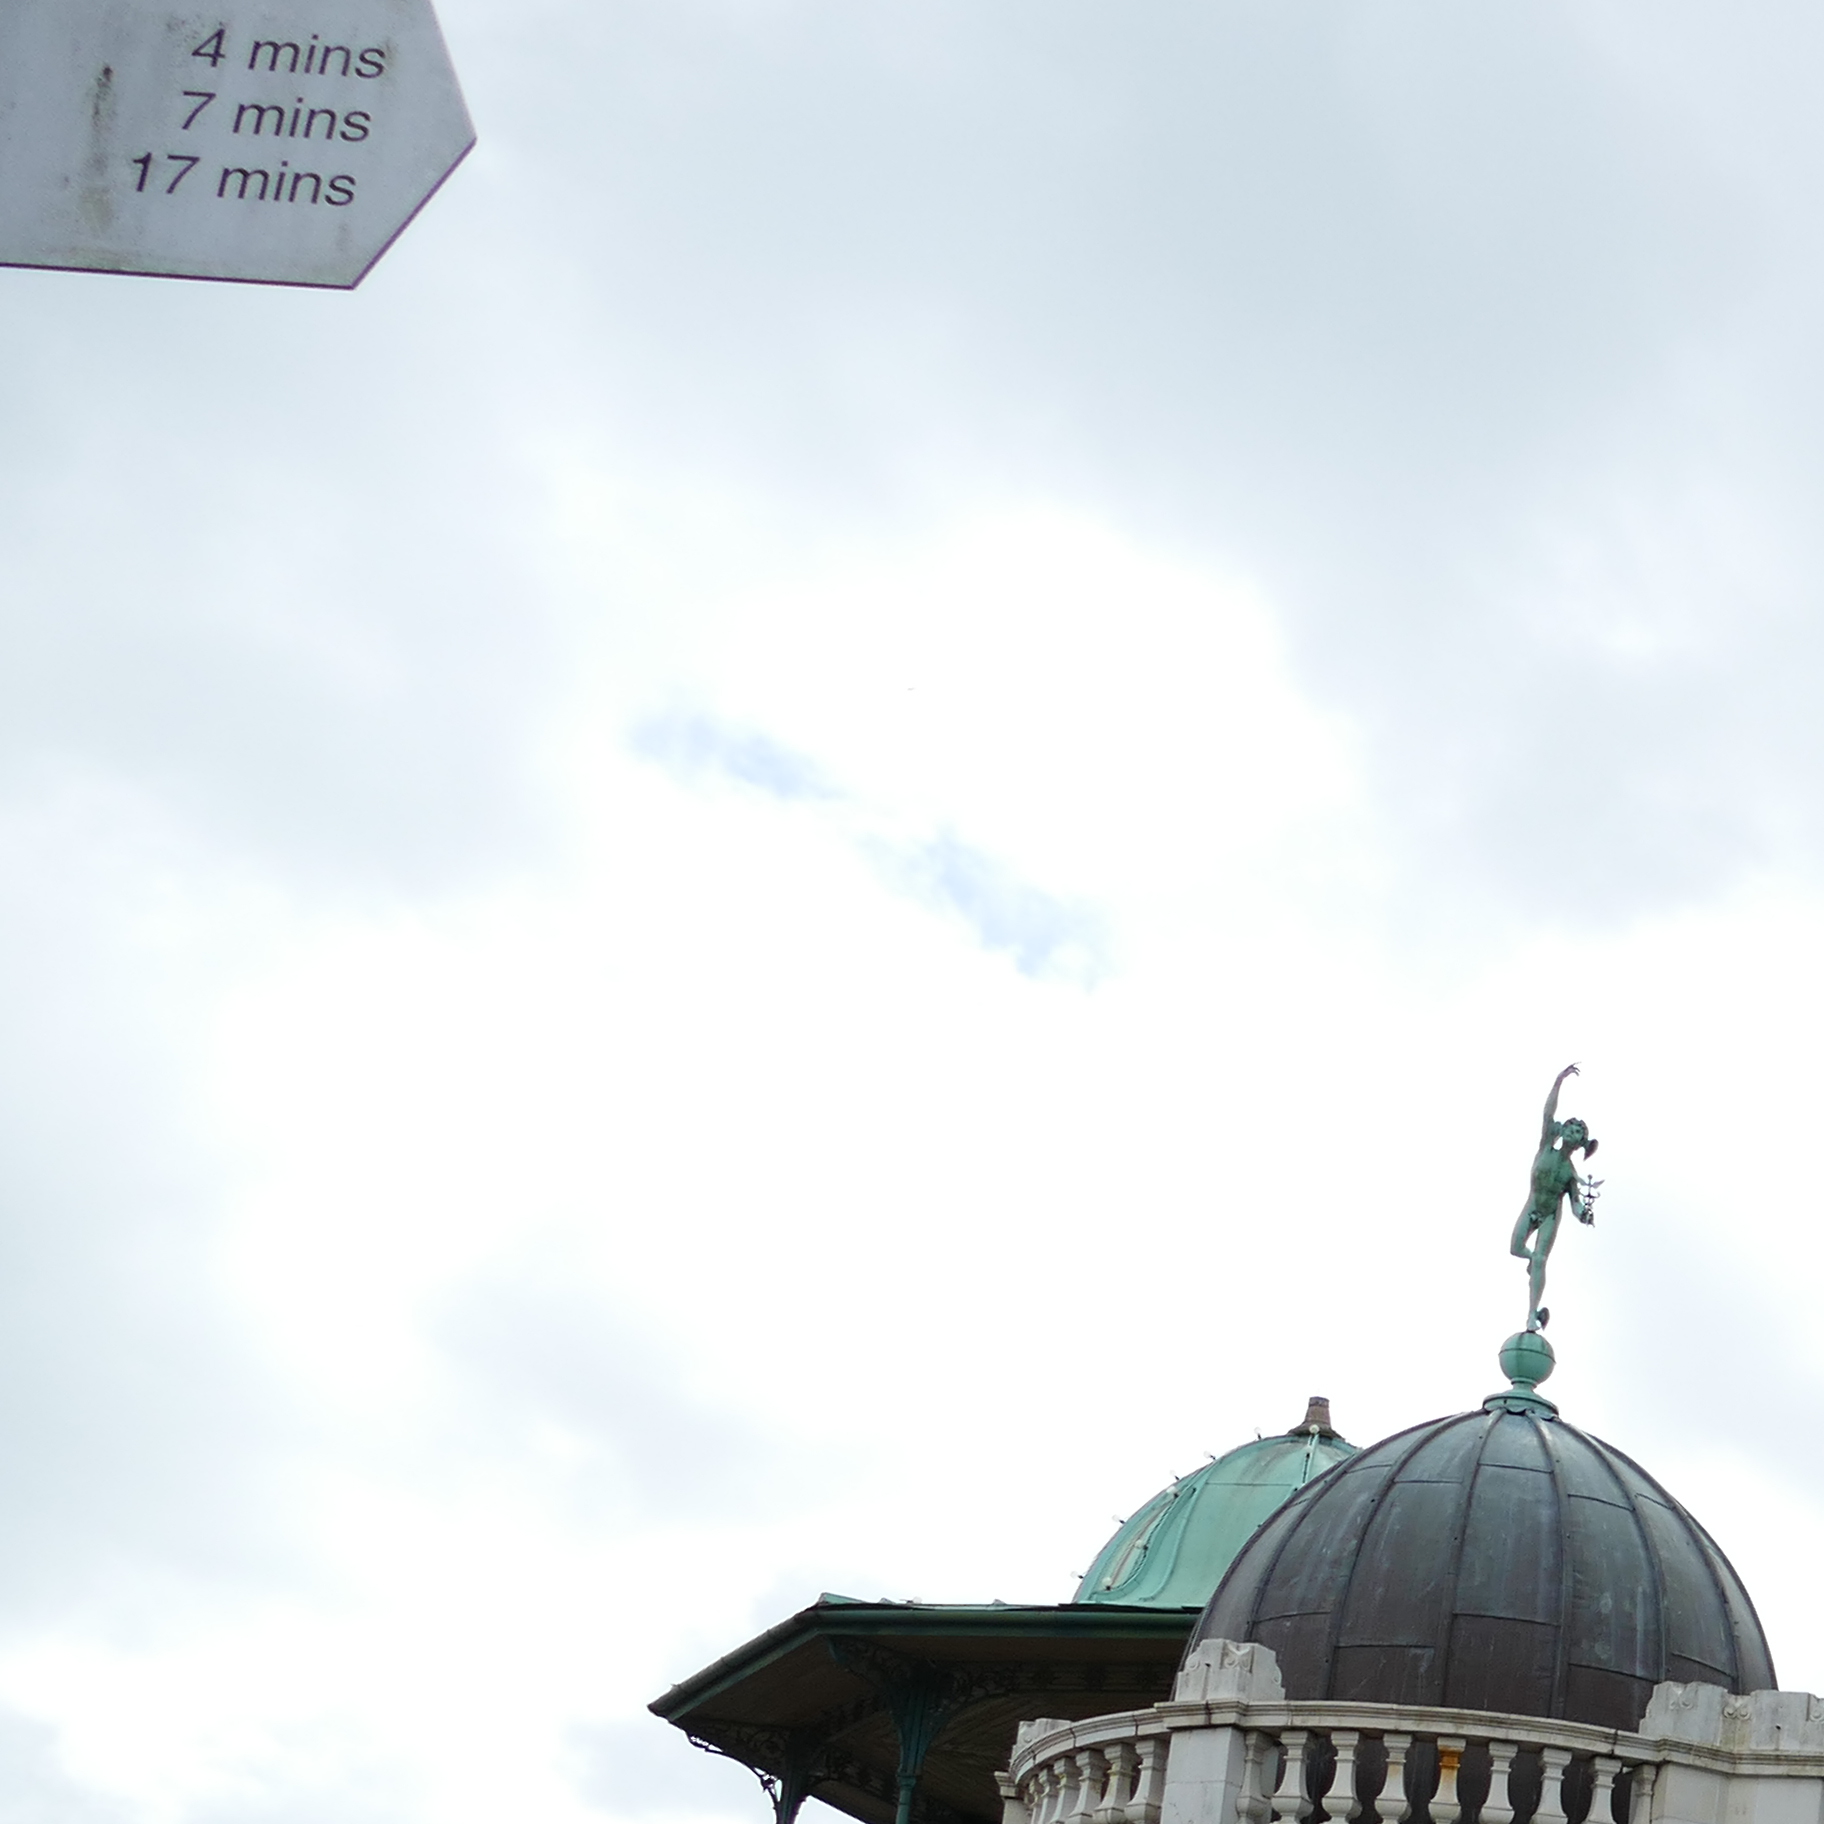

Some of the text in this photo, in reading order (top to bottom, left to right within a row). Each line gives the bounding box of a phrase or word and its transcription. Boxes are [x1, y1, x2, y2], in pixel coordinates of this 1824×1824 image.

[190, 28, 387, 80] 4 mins
[180, 91, 372, 143] 7 mins
[131, 152, 357, 207] 17 mins
